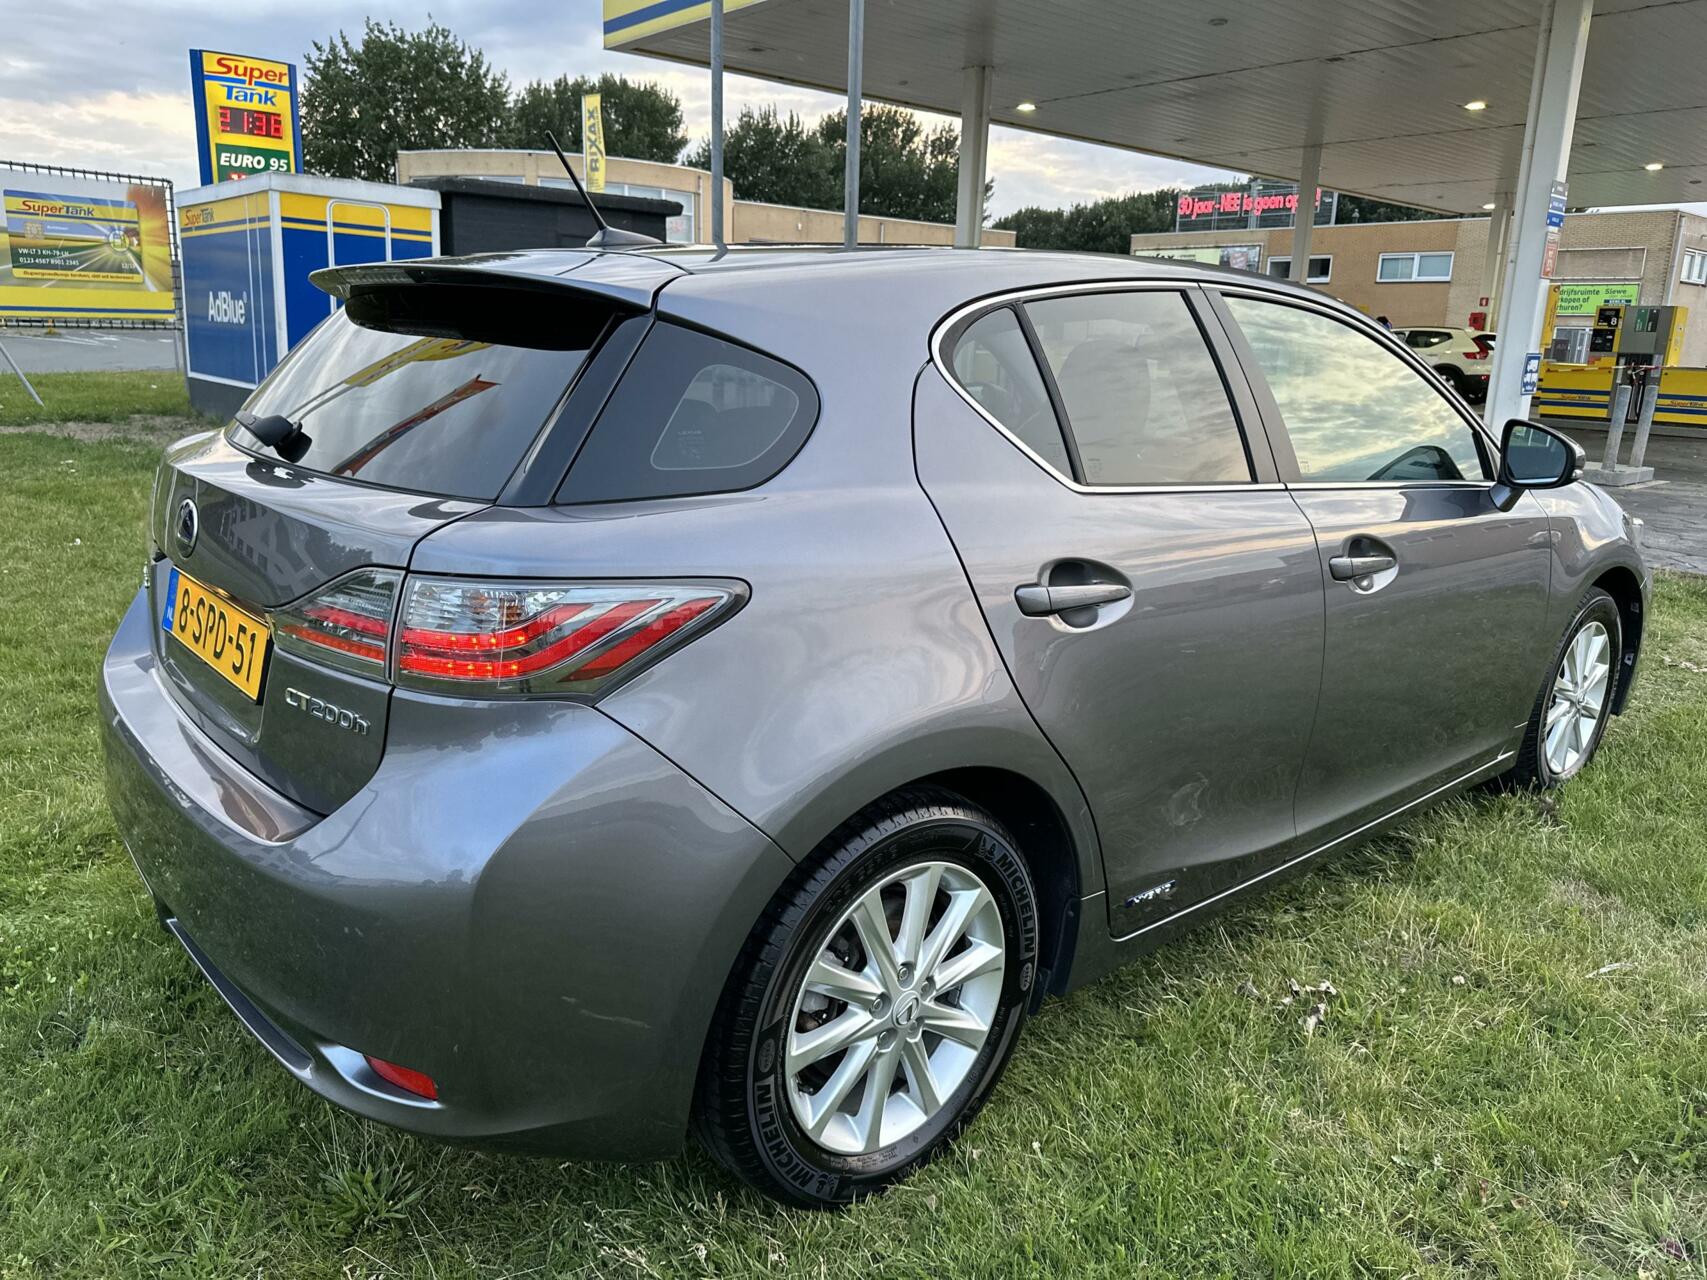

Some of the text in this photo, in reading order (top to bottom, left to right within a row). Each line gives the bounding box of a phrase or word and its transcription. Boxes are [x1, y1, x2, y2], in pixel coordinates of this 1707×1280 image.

[205, 56, 288, 86] Super
[220, 84, 277, 106] Tank
[220, 152, 288, 171] EURO 95
[1560, 288, 1600, 296] drijfsruimte
[1610, 317, 1618, 326] 8
[178, 587, 257, 683] 8-SPD-51
[285, 687, 371, 735] CT200h
[996, 852, 1035, 953] MICHELIN
[756, 1084, 816, 1187] MICHELIN
